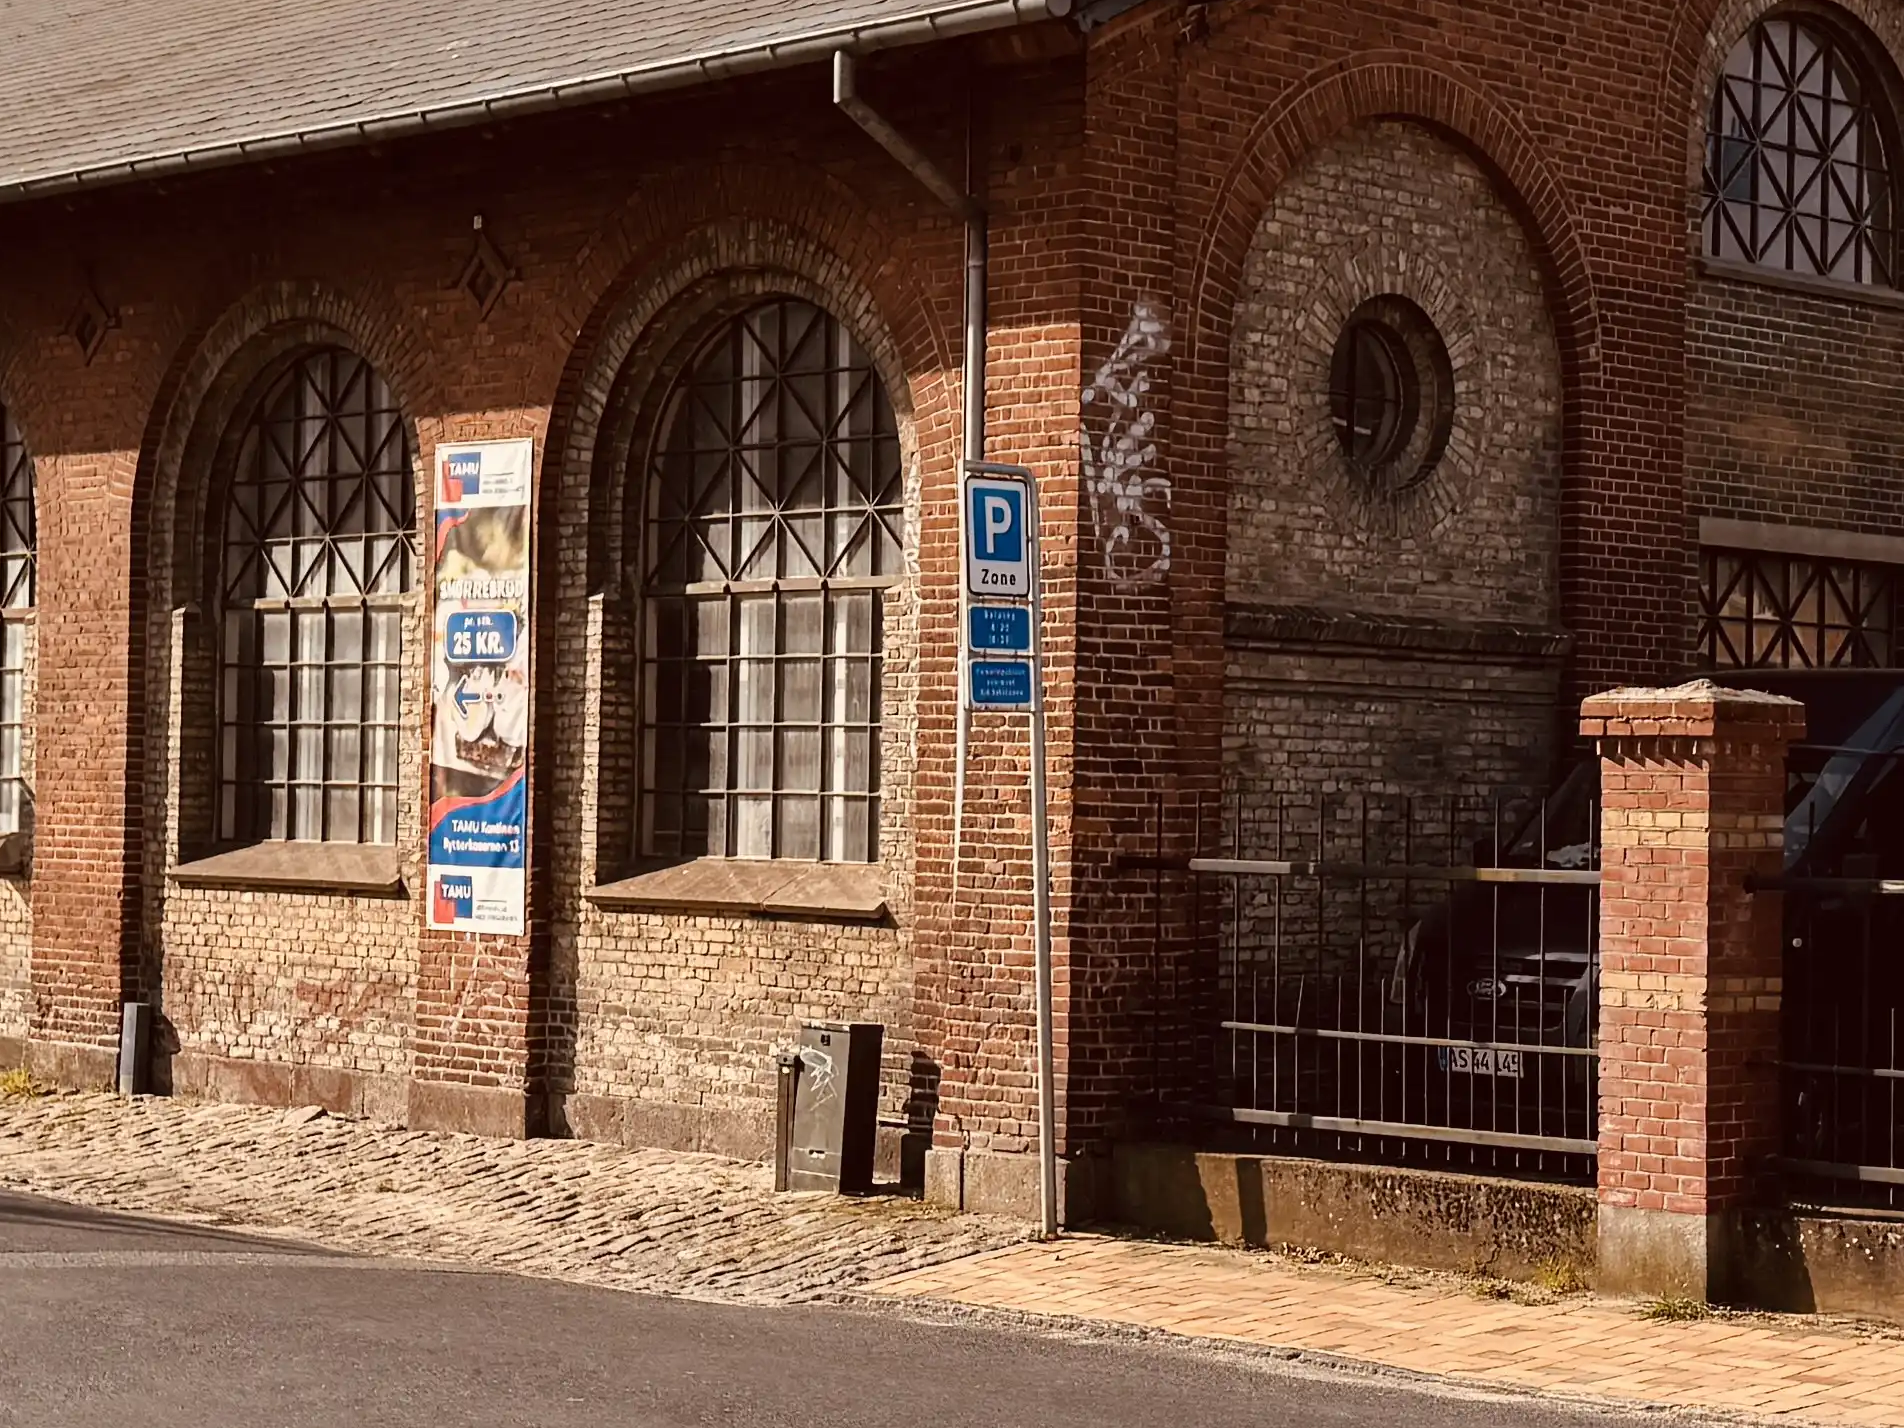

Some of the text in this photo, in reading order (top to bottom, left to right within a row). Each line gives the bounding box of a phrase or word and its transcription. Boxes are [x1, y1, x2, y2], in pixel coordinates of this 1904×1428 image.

[448, 462, 479, 476] TAMU
[984, 496, 1012, 554] P
[981, 568, 1016, 585] Zone
[453, 631, 505, 655] 25 KR.
[451, 819, 480, 833] TAMU
[441, 884, 471, 899] TAMU
